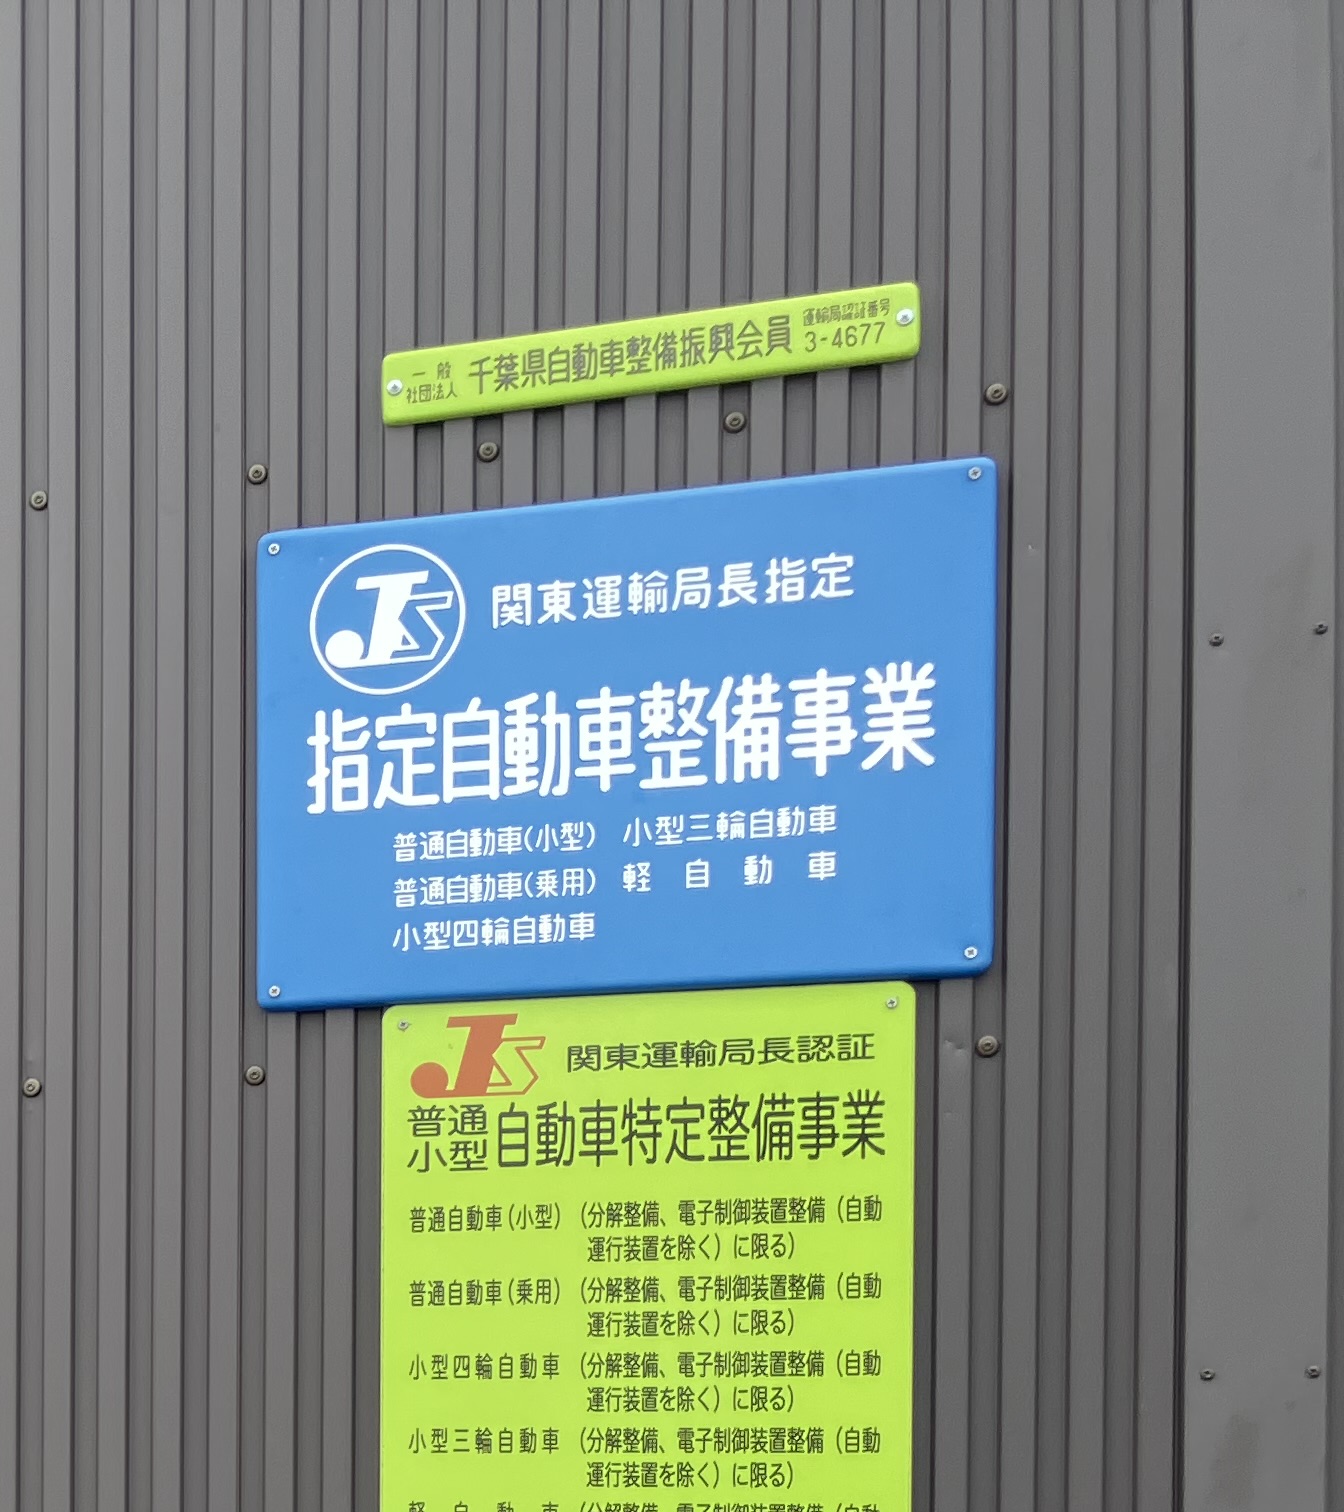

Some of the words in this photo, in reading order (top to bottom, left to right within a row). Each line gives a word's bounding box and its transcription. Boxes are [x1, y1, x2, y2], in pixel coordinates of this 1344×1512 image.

[467, 314, 793, 395] 千葉県自動車整備振興会員
[805, 322, 886, 352] 3-4677
[406, 382, 458, 404] 社団法人
[491, 552, 855, 630] 関東運輸局長指定
[306, 660, 937, 815] 指定自動車整備事業
[622, 805, 838, 848] 小型三輪自動車
[392, 912, 597, 953] 小型四輪自動車
[566, 1032, 876, 1073] 関東運輸局長認証
[408, 1104, 488, 1138] 普通
[497, 1088, 886, 1169] 自動車特定整備事業
[407, 1140, 489, 1173] 小型
